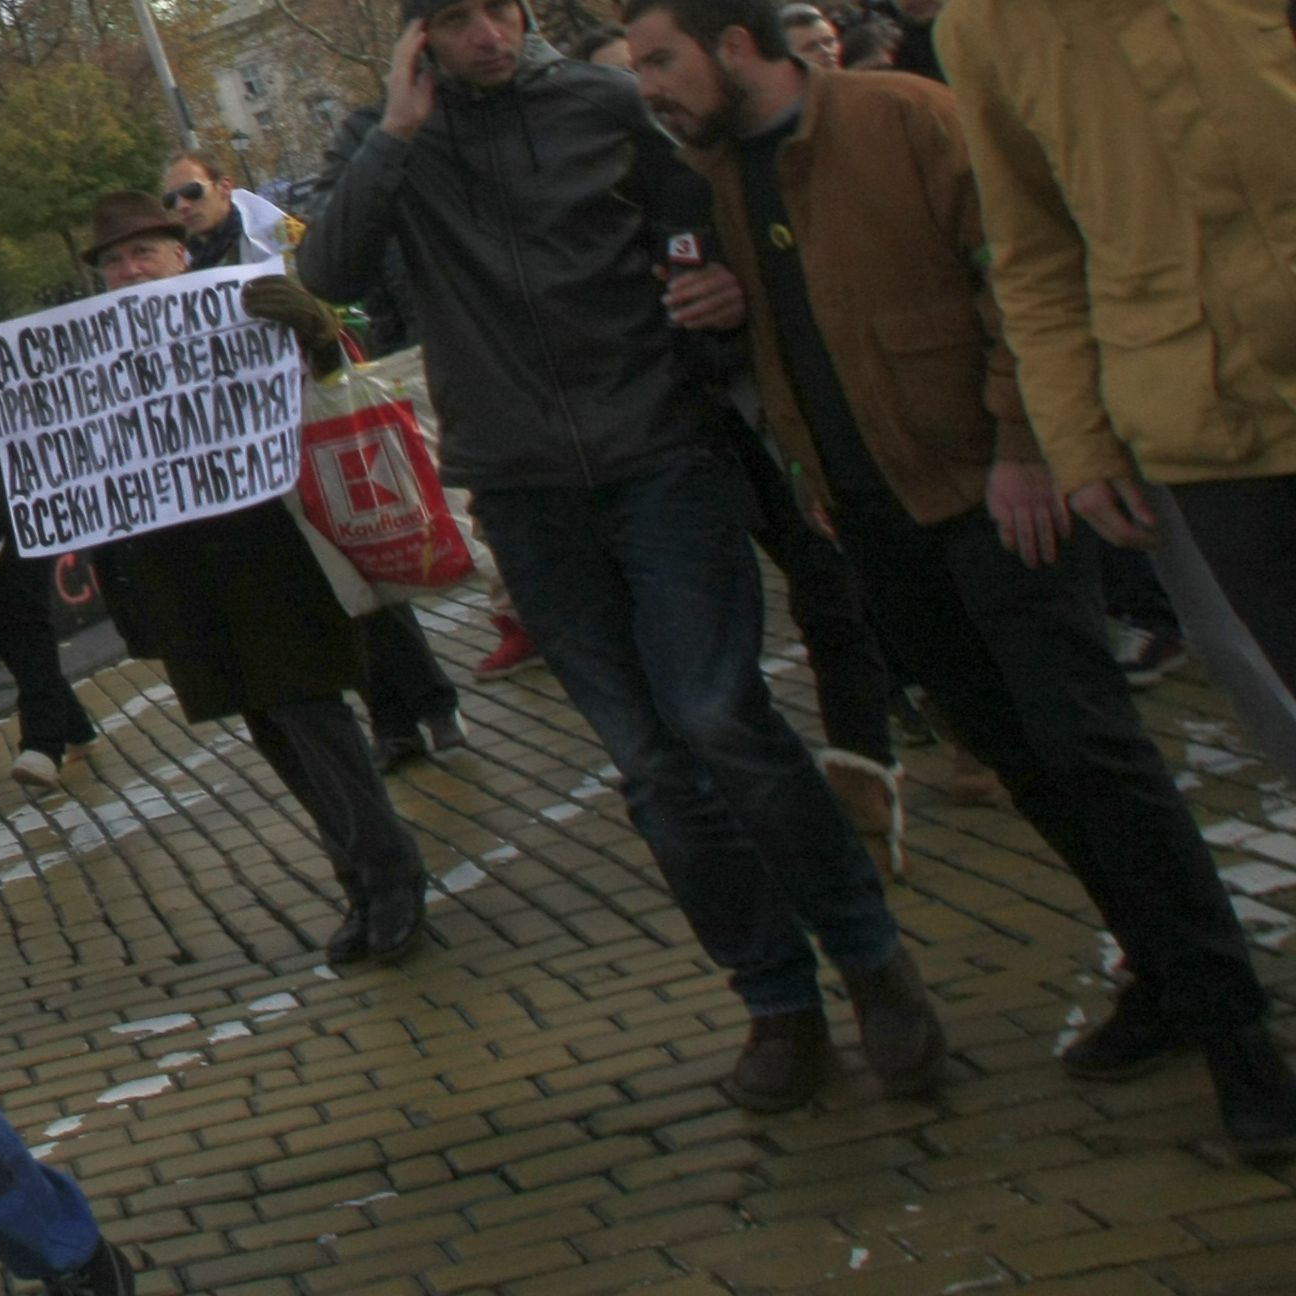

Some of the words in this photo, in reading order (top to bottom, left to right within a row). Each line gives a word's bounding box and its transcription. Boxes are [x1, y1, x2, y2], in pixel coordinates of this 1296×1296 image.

[116, 280, 242, 351] ТУРСКОТ
[6, 439, 43, 499] ДА
[35, 405, 148, 488] СПАСИМ
[12, 483, 104, 550] ВСЕКИ
[104, 467, 157, 536] ДЕН
[338, 491, 424, 539] Kaufland
